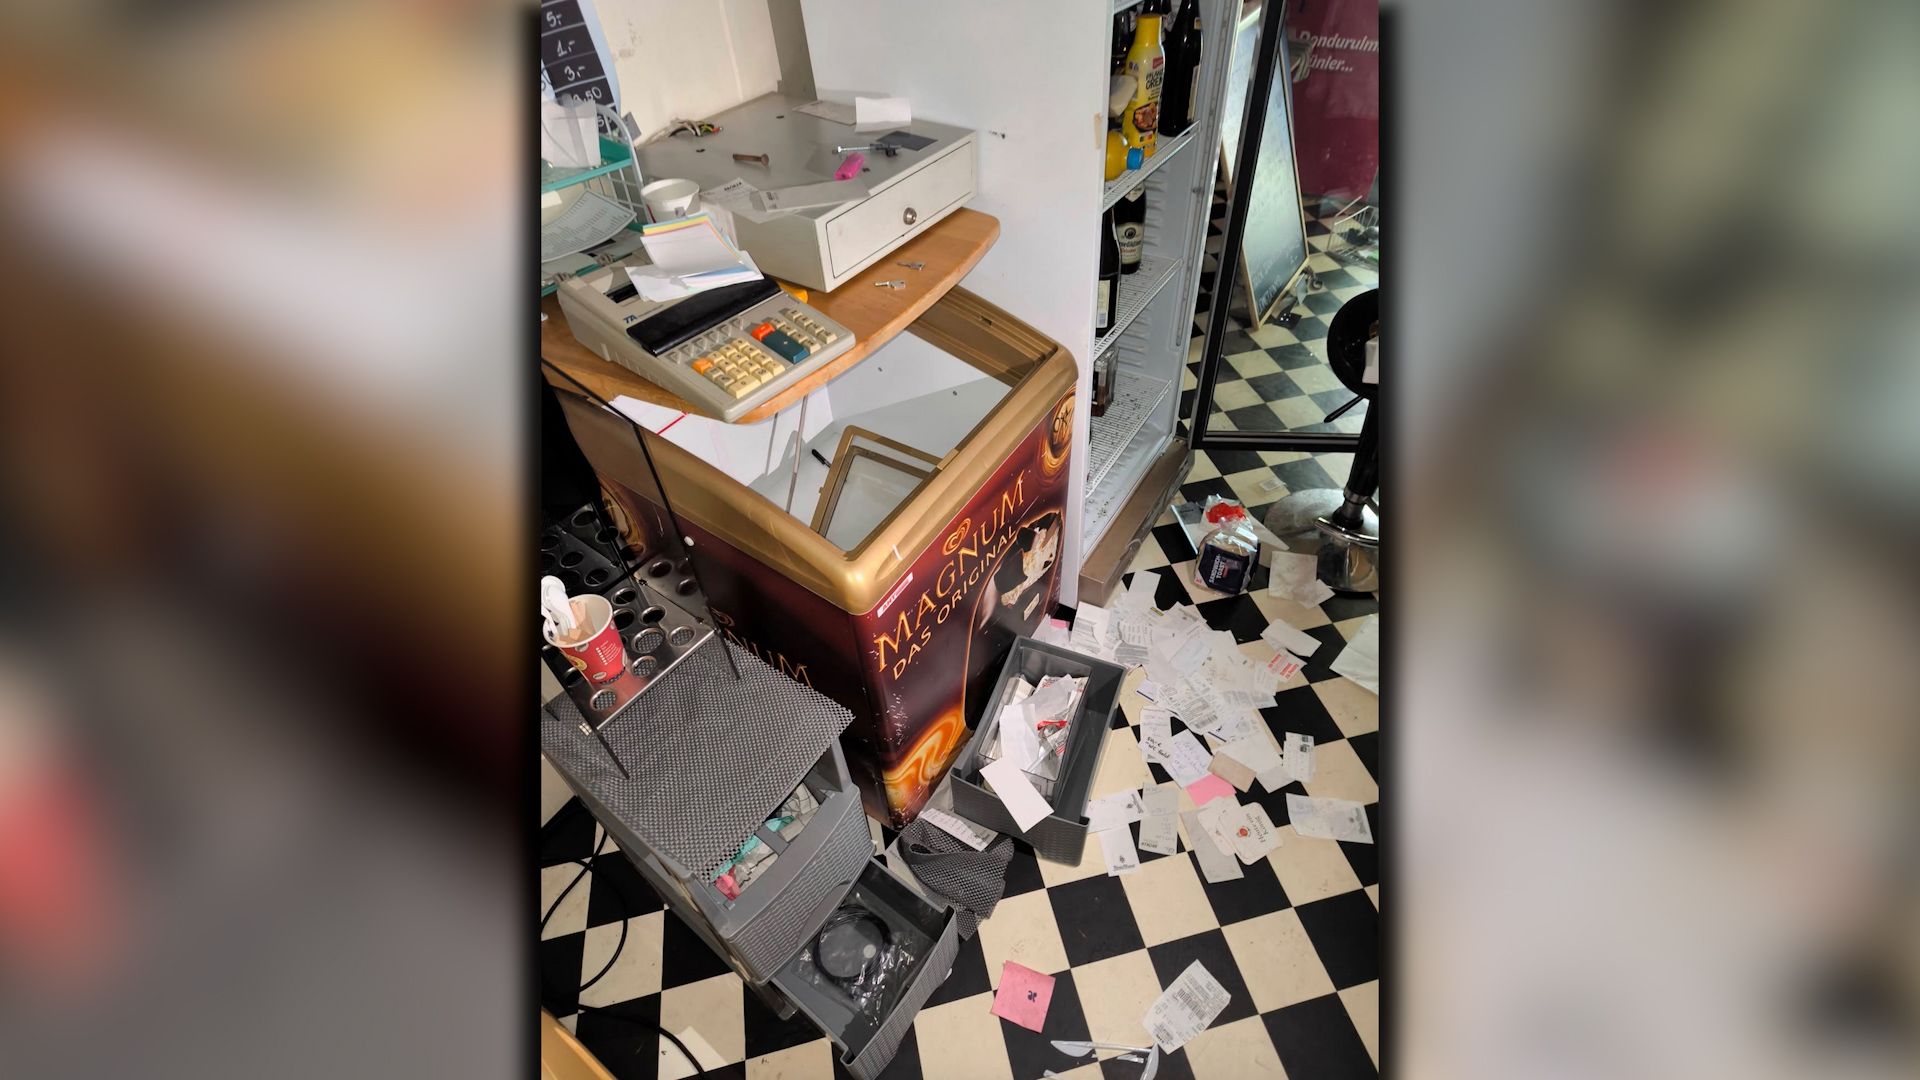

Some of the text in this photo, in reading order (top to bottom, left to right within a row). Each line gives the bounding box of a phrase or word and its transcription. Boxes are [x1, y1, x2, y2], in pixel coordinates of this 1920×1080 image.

[874, 469, 1025, 673] MAGNUM
[892, 525, 1017, 680] DAS ORIGINAL
[1216, 560, 1227, 579] TOAST
[1252, 823, 1266, 843] Heute
